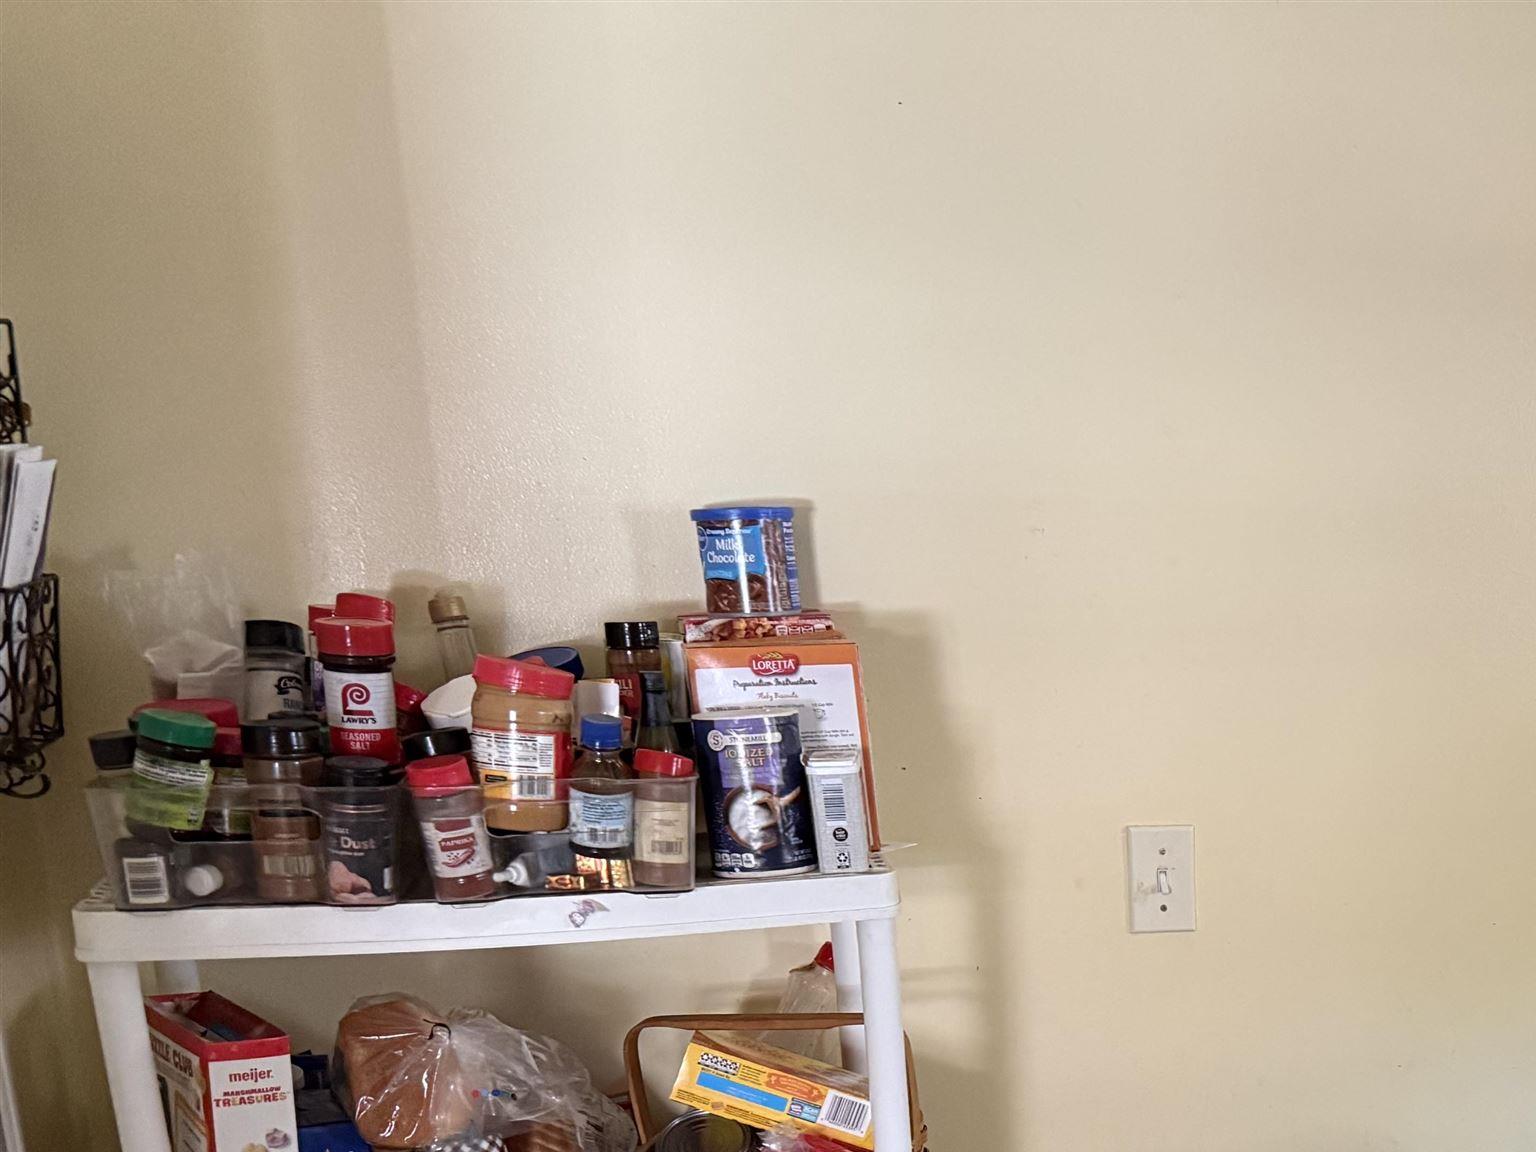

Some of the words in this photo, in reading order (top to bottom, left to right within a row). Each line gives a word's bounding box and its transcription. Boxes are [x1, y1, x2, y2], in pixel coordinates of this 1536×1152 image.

[715, 538, 740, 550] Milk
[707, 551, 756, 563] Chocolte
[752, 660, 795, 671] LORETTA
[341, 731, 382, 741] SEASONED
[729, 734, 767, 743] STNEMILL
[350, 741, 371, 751] SALT
[725, 748, 774, 759] IOIZED
[229, 1068, 273, 1082] meijer
[223, 1086, 281, 1096] MARSHMALLOW
[214, 1092, 288, 1108] TREASURES
